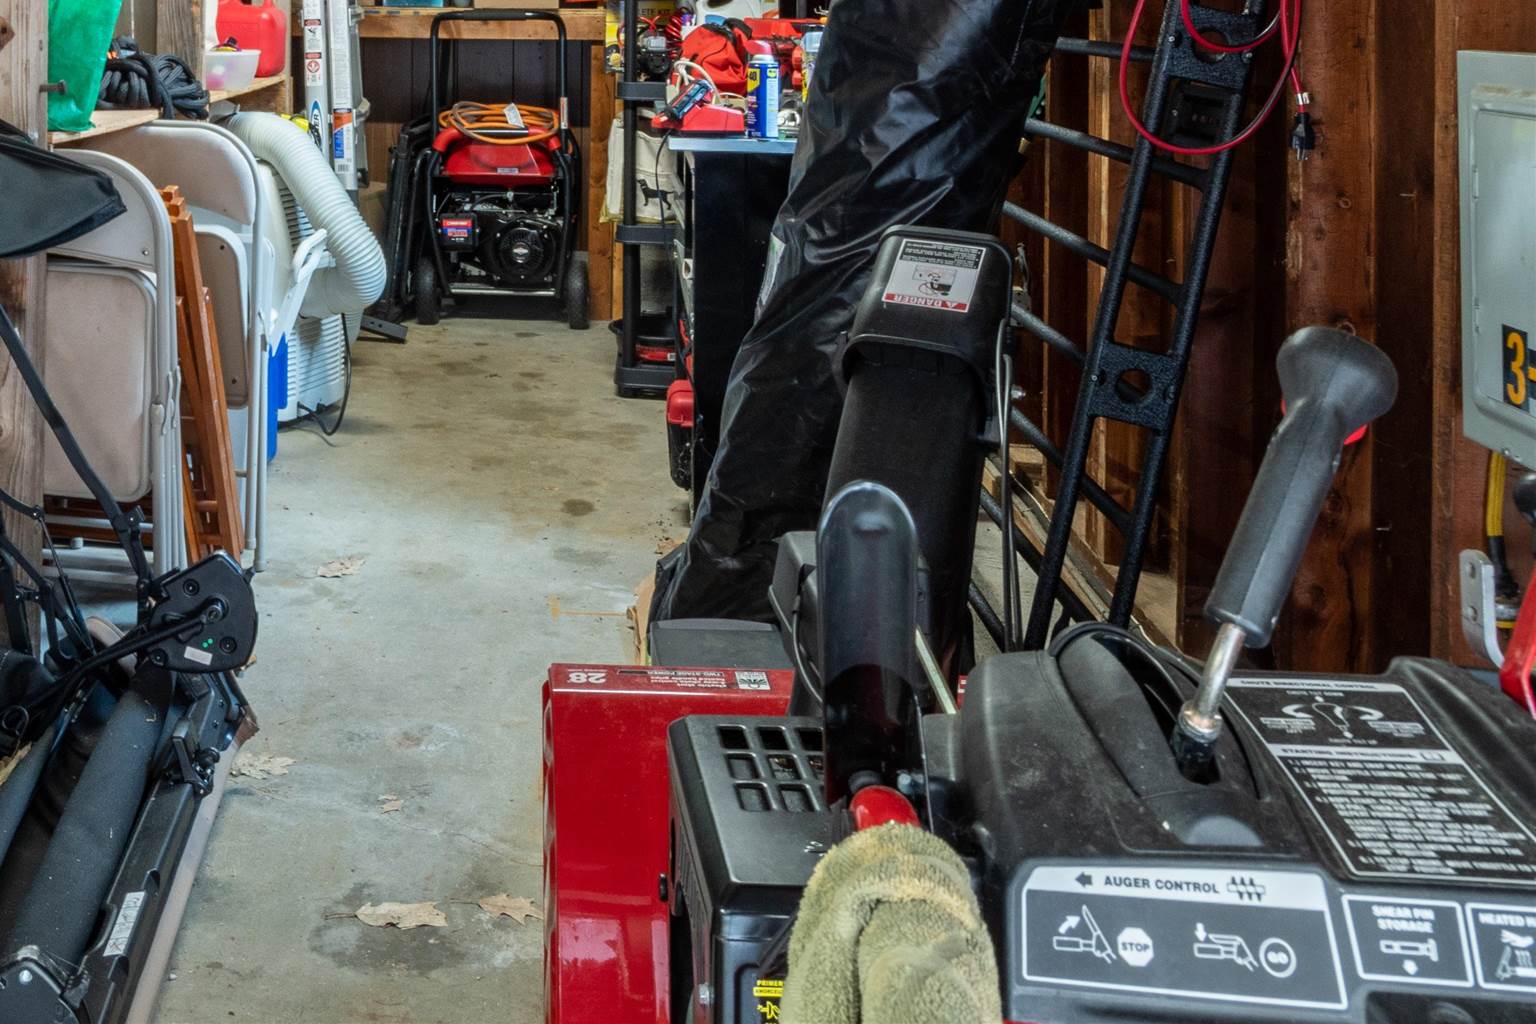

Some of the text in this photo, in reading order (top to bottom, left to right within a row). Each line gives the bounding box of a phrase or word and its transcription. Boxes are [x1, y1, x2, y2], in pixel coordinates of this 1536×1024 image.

[895, 293, 942, 308] DANGER
[1240, 679, 1271, 687] CHUTE
[1280, 747, 1417, 759] STARTING INSTRUCTIONS
[1103, 875, 1220, 894] AUGER CONTROL
[1371, 904, 1435, 920] SHEAR PIN
[1477, 912, 1524, 927] HEATED
[1376, 918, 1435, 934] STORAGE
[1121, 941, 1150, 953] STOP
